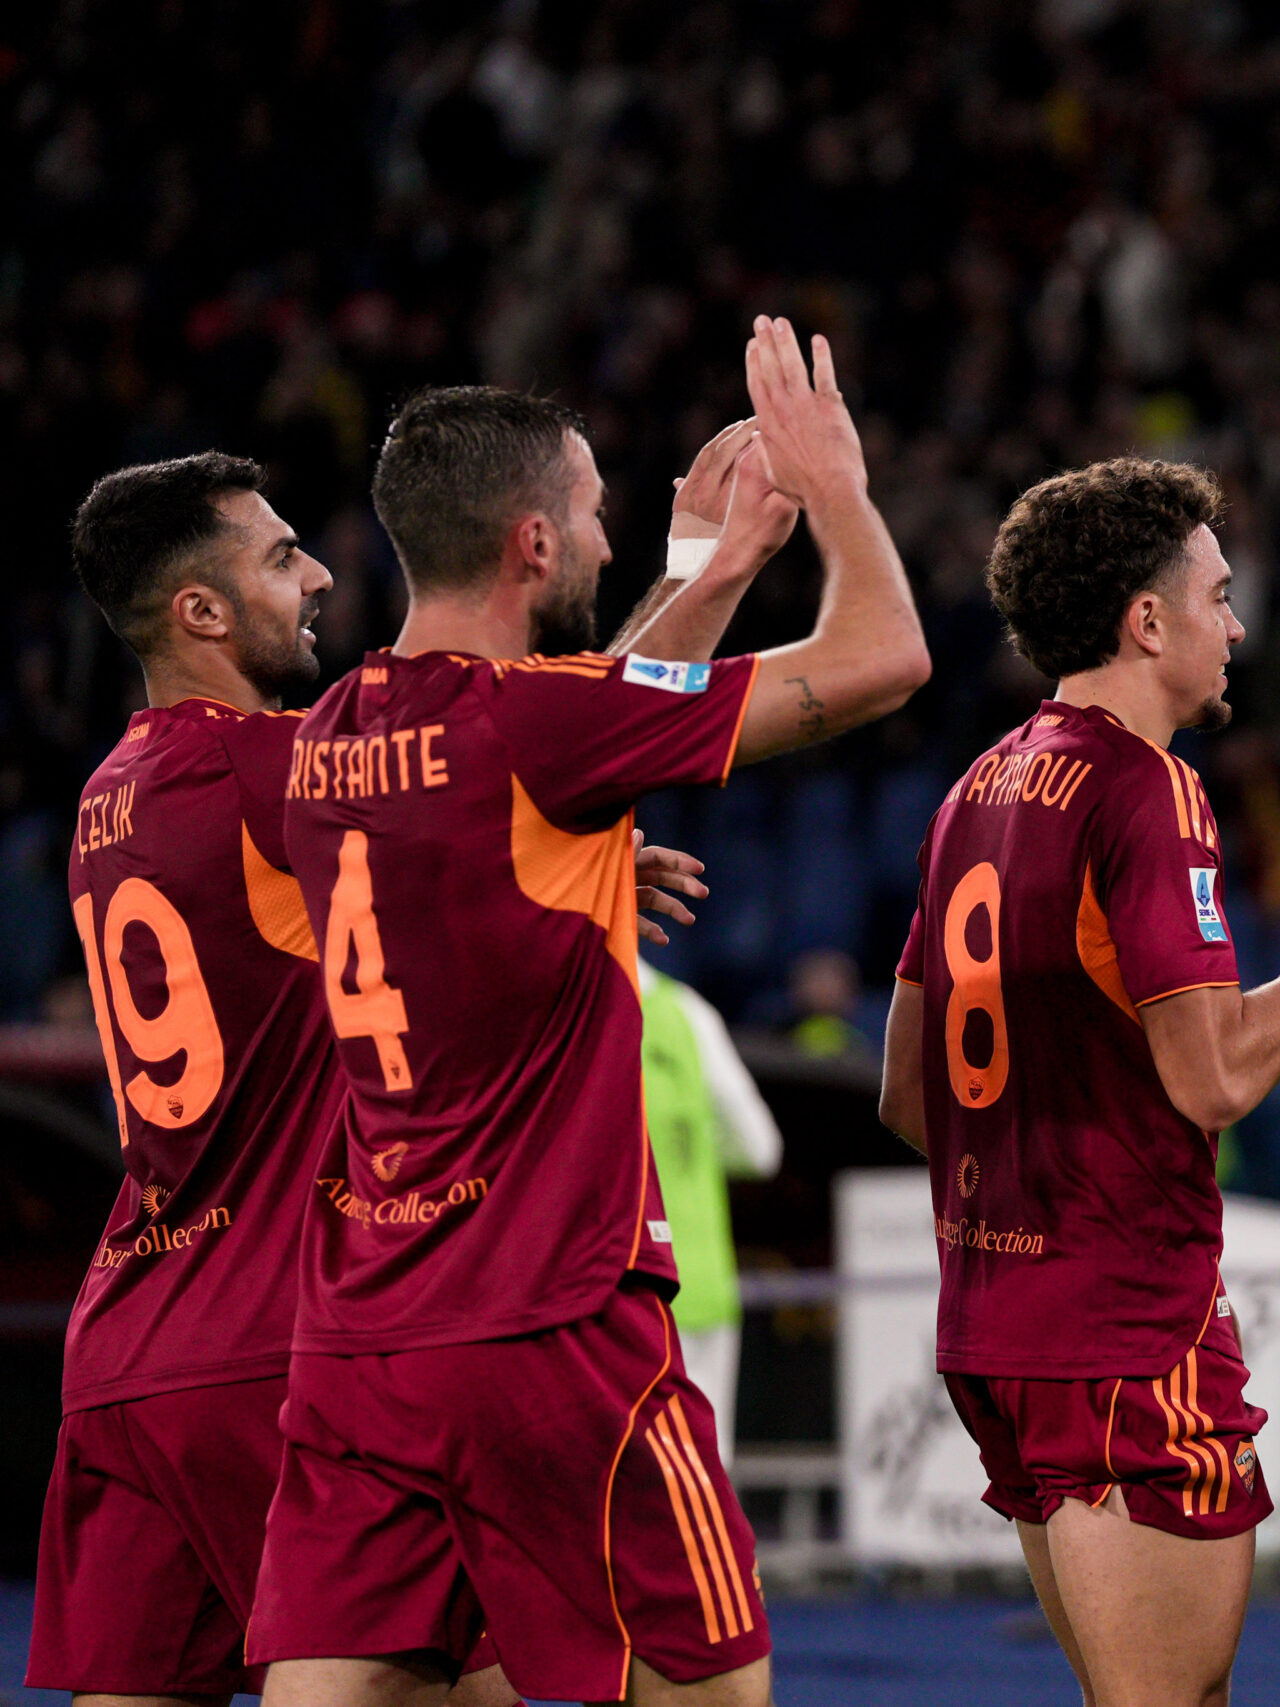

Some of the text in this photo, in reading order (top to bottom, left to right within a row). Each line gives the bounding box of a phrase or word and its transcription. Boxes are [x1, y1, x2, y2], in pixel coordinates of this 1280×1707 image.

[78, 780, 136, 864] ÇELIK
[286, 724, 450, 800] RISTANTE
[73, 877, 225, 1148] 19
[324, 830, 412, 1092] 4
[944, 861, 1010, 1109] 8
[959, 1217, 1044, 1254] Collection
